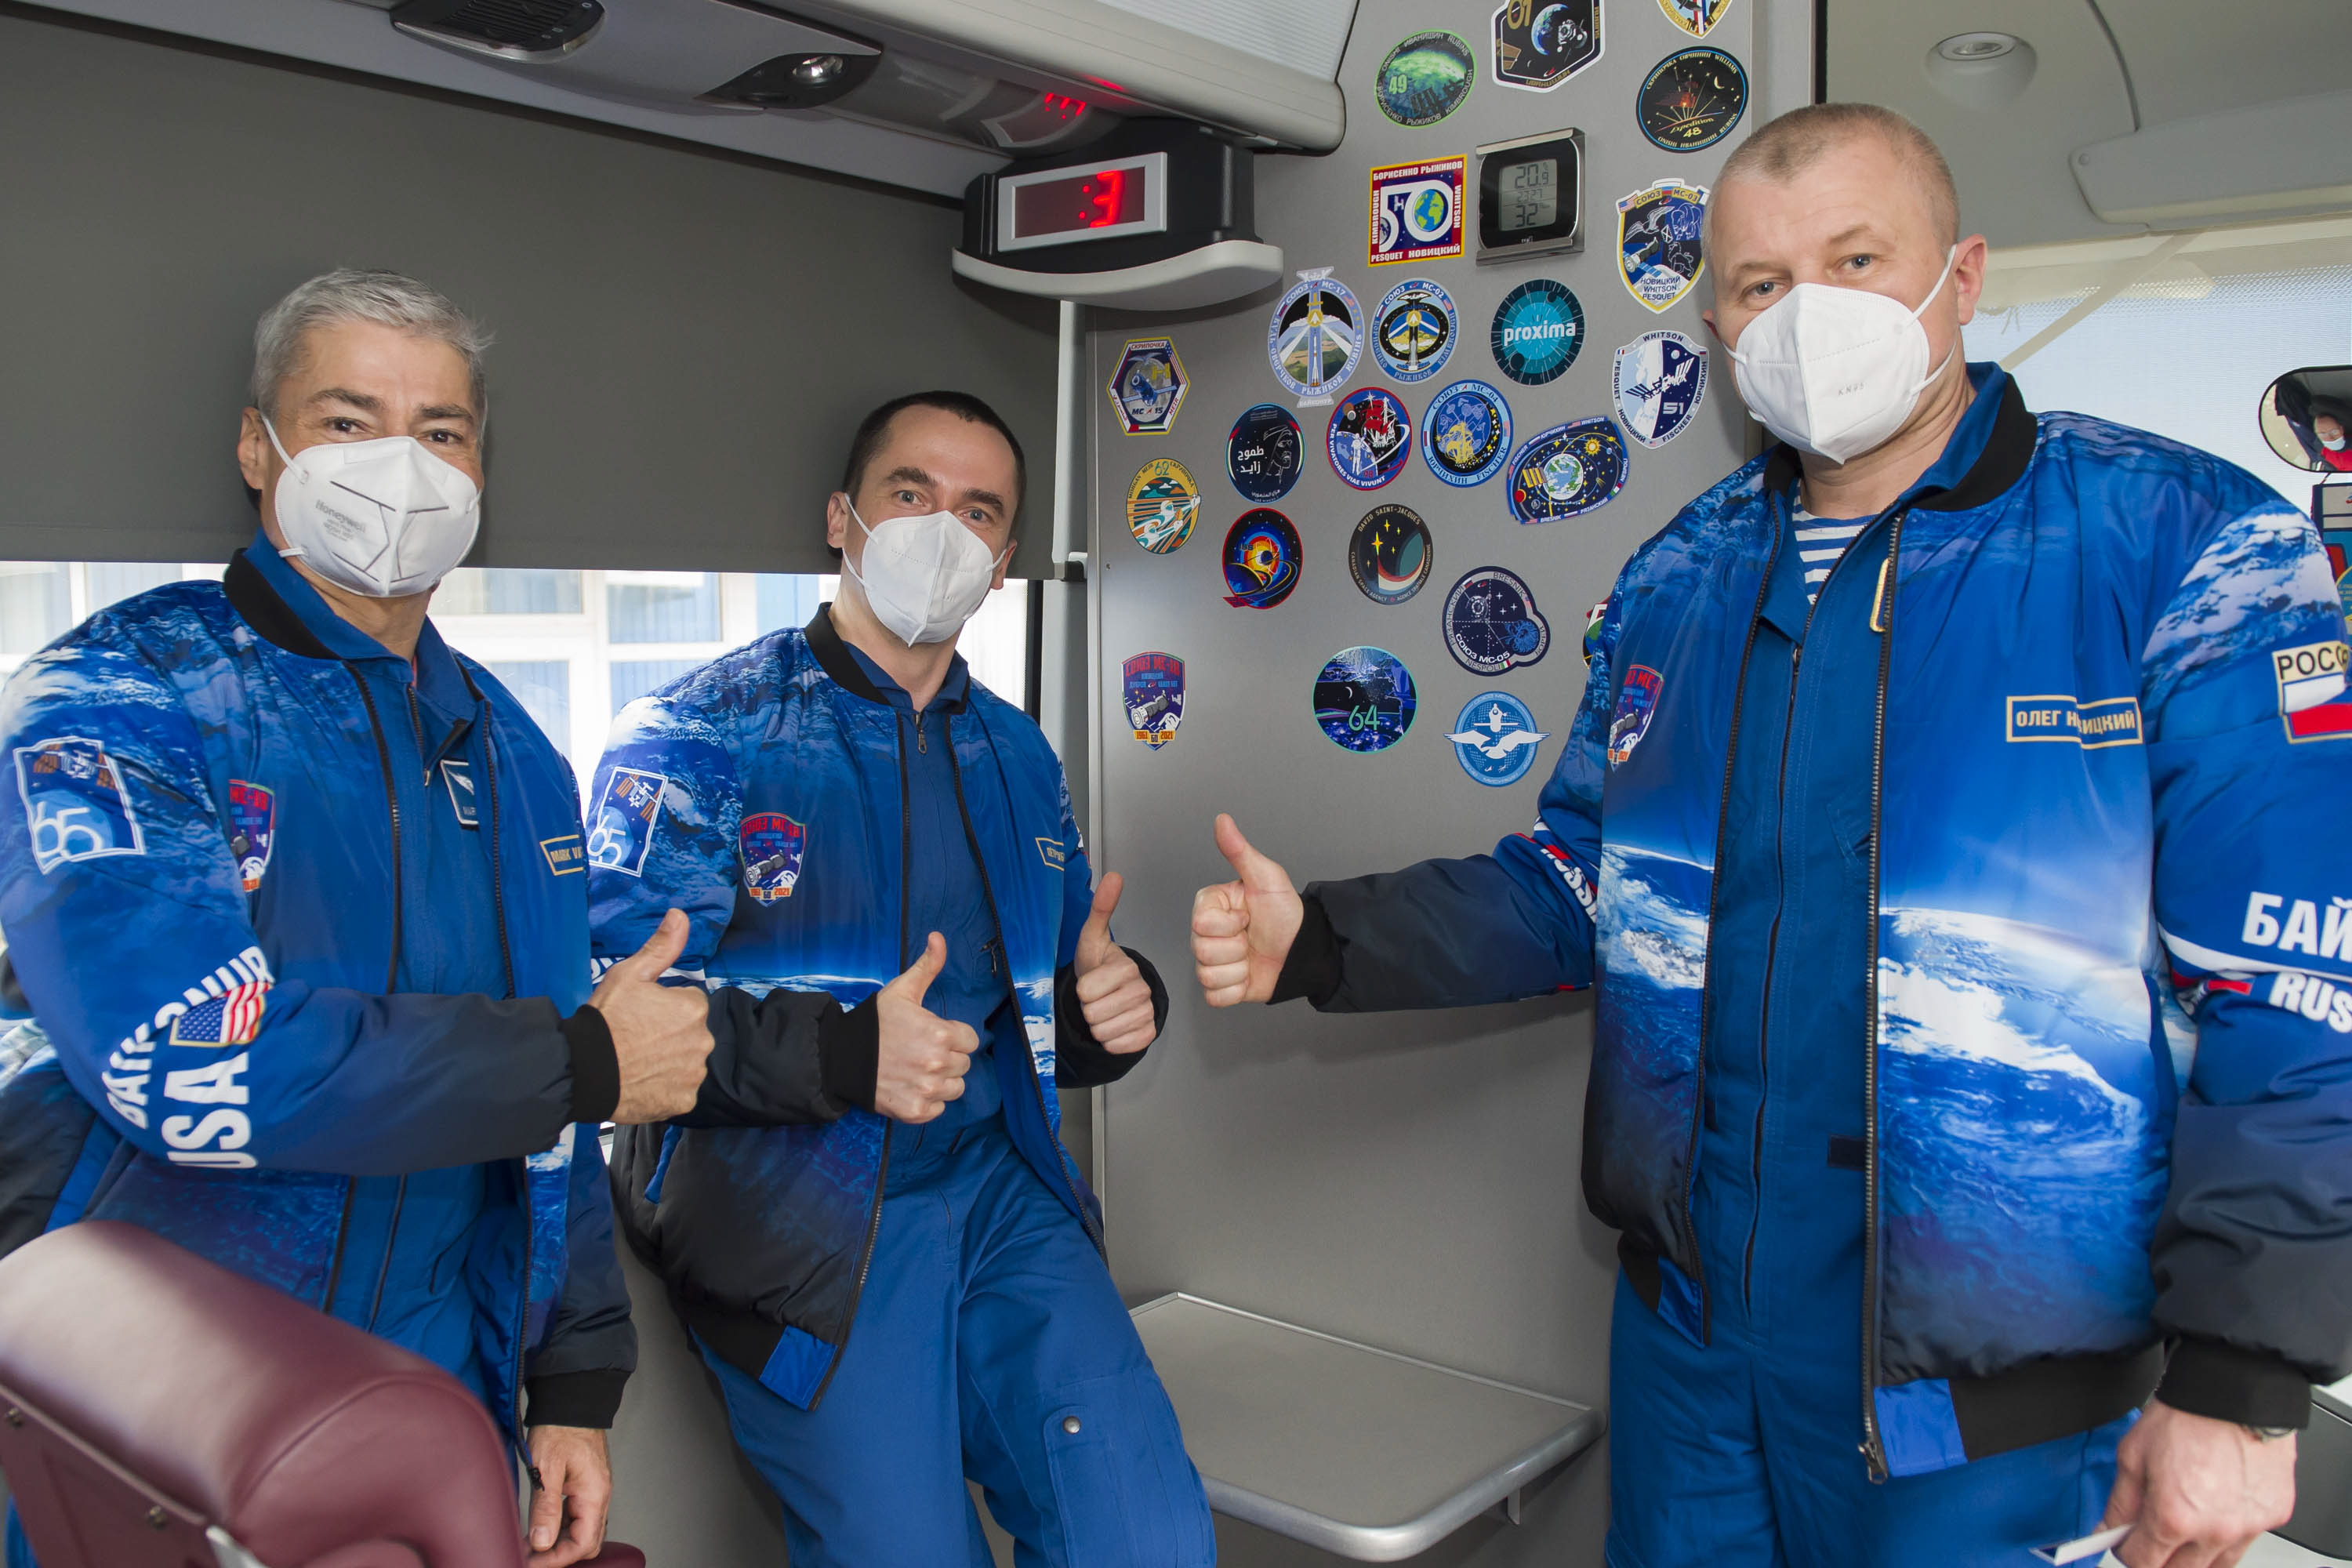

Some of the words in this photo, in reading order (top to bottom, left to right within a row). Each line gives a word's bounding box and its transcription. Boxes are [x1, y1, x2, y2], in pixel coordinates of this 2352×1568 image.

[1403, 32, 1444, 47] ИВАНИШИН
[1388, 74, 1407, 94] 49
[1406, 113, 1442, 125] РЫЖИКОВ
[1682, 126, 1702, 137] 48
[1373, 167, 1418, 181] БОРИСЕНКО
[1421, 161, 1463, 174] РЫЖИКОВ
[1454, 184, 1462, 229] WHITSON
[1636, 191, 1661, 205] СОЮЗ
[1673, 189, 1699, 201] МС-03
[1371, 190, 1380, 245] KIMBROUGH
[1379, 180, 1454, 253] 50
[1515, 203, 1538, 227] 32
[1370, 251, 1403, 263] PESQUET
[1408, 243, 1461, 258] НОВИЦКИЙ
[1286, 283, 1308, 303] СОЮЗ
[1322, 281, 1346, 296] МС-17
[1385, 285, 1405, 304] СОЮЗ
[1422, 282, 1444, 298] МС-02
[1504, 320, 1577, 347] proxima
[1642, 332, 1683, 342] WHITSON
[1301, 375, 1343, 395] РЫЖИКОВ
[1694, 361, 1707, 405] ЮРЧИХИН
[1433, 387, 1459, 410] СОЮЗ
[1471, 384, 1499, 402] МС-04
[1662, 402, 1684, 415] 51
[1581, 416, 1605, 425] WHITSON
[1662, 414, 1692, 442] FISCHER
[1237, 445, 1264, 461] طموح
[1476, 447, 1507, 481] FISCHER
[1512, 445, 1528, 465] FISCHER
[1153, 461, 1170, 476] 62
[1240, 461, 1261, 474] زايد
[1428, 456, 1468, 484] ЮРЧИХИН
[1346, 474, 1360, 485] VIAE
[1361, 476, 1385, 486] VIVUNT
[315, 499, 367, 533] Honeywell
[1358, 514, 1374, 532] DAVID
[1375, 506, 1421, 525] SAINT-JACQUES
[1494, 572, 1526, 596] BRESNIK
[1456, 633, 1477, 659] СОЮЗ
[1479, 651, 1510, 663] МС-05
[1465, 658, 1501, 672] NESPOLI
[1348, 705, 1380, 731] 64
[2016, 710, 2062, 727] ОЛЕГ
[2066, 710, 2136, 735] НИЦКИЙ
[33, 801, 103, 859] 65
[587, 815, 626, 866] 65
[2242, 891, 2352, 962] БАЙ
[2268, 971, 2352, 1033] RUS
[162, 1051, 258, 1169] USA
